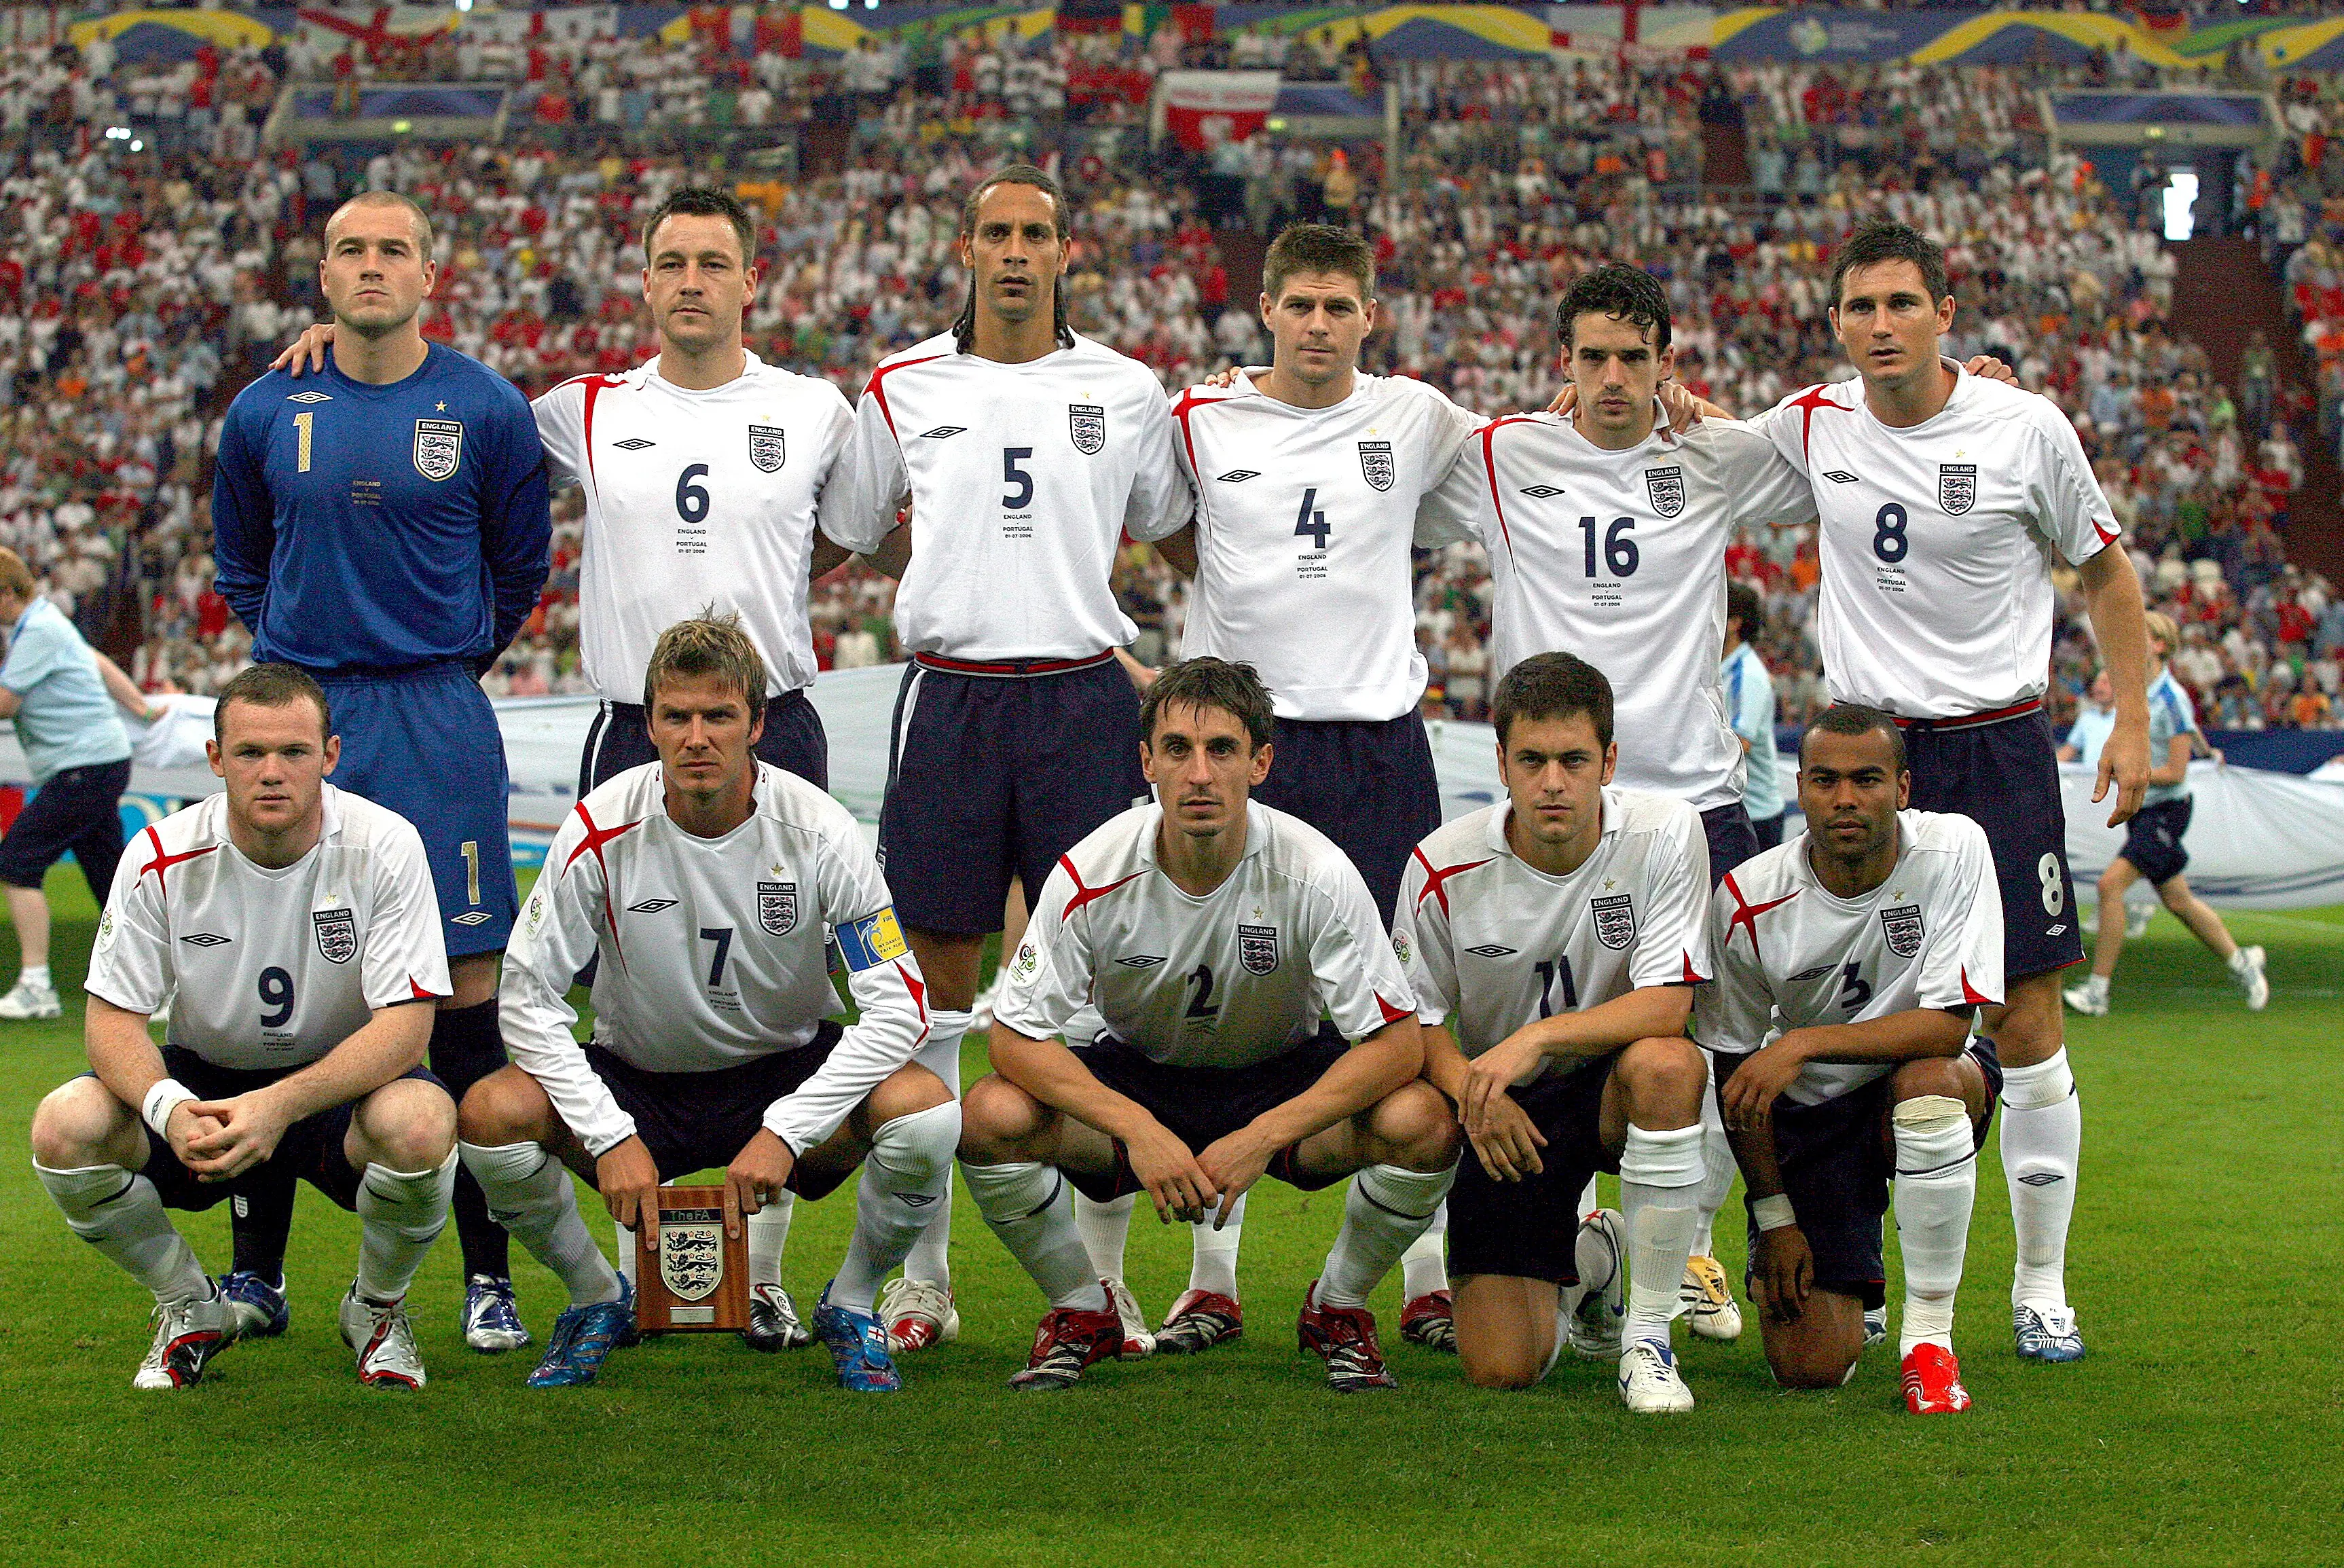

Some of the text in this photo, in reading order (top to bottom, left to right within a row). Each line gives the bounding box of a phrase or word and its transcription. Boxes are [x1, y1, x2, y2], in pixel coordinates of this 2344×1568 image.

[422, 422, 458, 431] ENGLAND
[751, 426, 782, 435] ENGLAND
[1071, 405, 1103, 414] ENGLAND
[293, 412, 313, 473] 1
[1941, 464, 1975, 473] ENGLAND
[676, 463, 710, 523] 6
[1002, 448, 1033, 509] 5
[1647, 468, 1679, 477] ENGLAND
[1294, 488, 1331, 549] 4
[1578, 516, 1639, 578] 16
[1873, 503, 1908, 563] 8
[1877, 578, 1907, 586] PORTUGAL
[460, 841, 480, 905] 1
[1594, 896, 1629, 907] ENGLAND
[2038, 852, 2064, 917] 8
[315, 910, 350, 919] ENGLAND
[1241, 926, 1275, 935] ENGLAND
[1883, 907, 1918, 918] ENGLAND
[700, 928, 733, 987] 7
[258, 966, 295, 1027] 9
[1184, 964, 1219, 1019] 2
[1535, 955, 1577, 1019] 11
